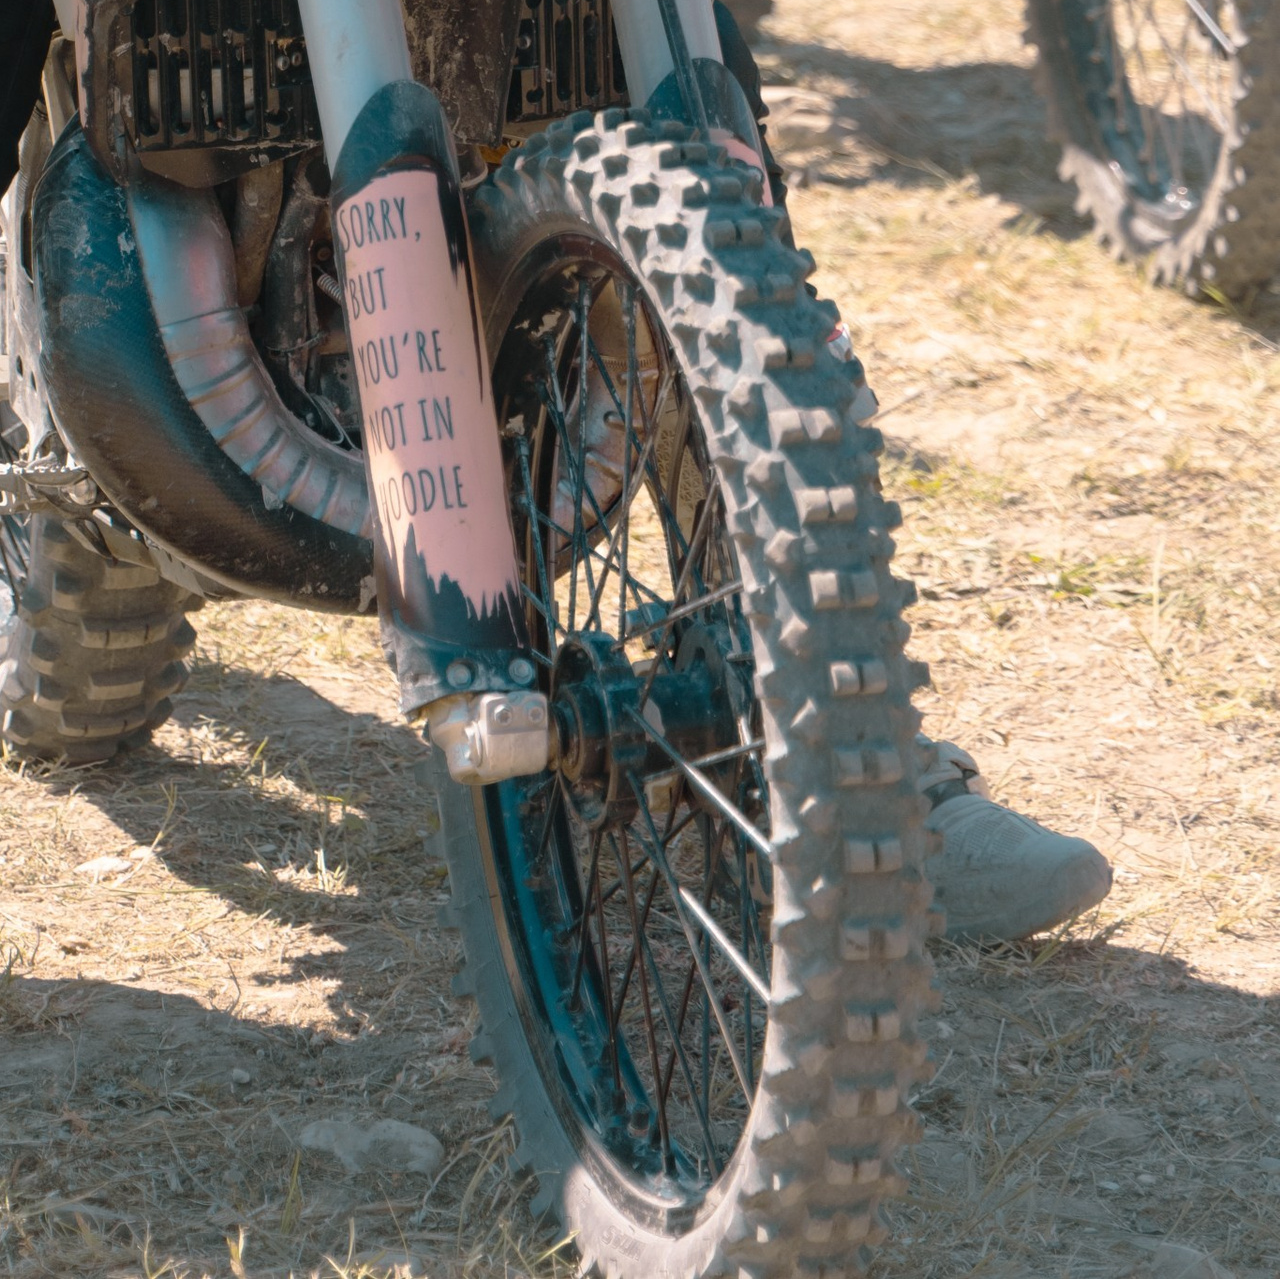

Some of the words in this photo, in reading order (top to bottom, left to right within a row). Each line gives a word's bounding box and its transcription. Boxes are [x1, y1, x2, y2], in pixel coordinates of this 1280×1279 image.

[339, 196, 421, 254] SORRY,
[349, 267, 388, 321] BUT
[358, 330, 447, 389] YOU'RE
[370, 402, 408, 457] NOT
[418, 395, 455, 442] IN
[379, 465, 469, 524] HOODLE
